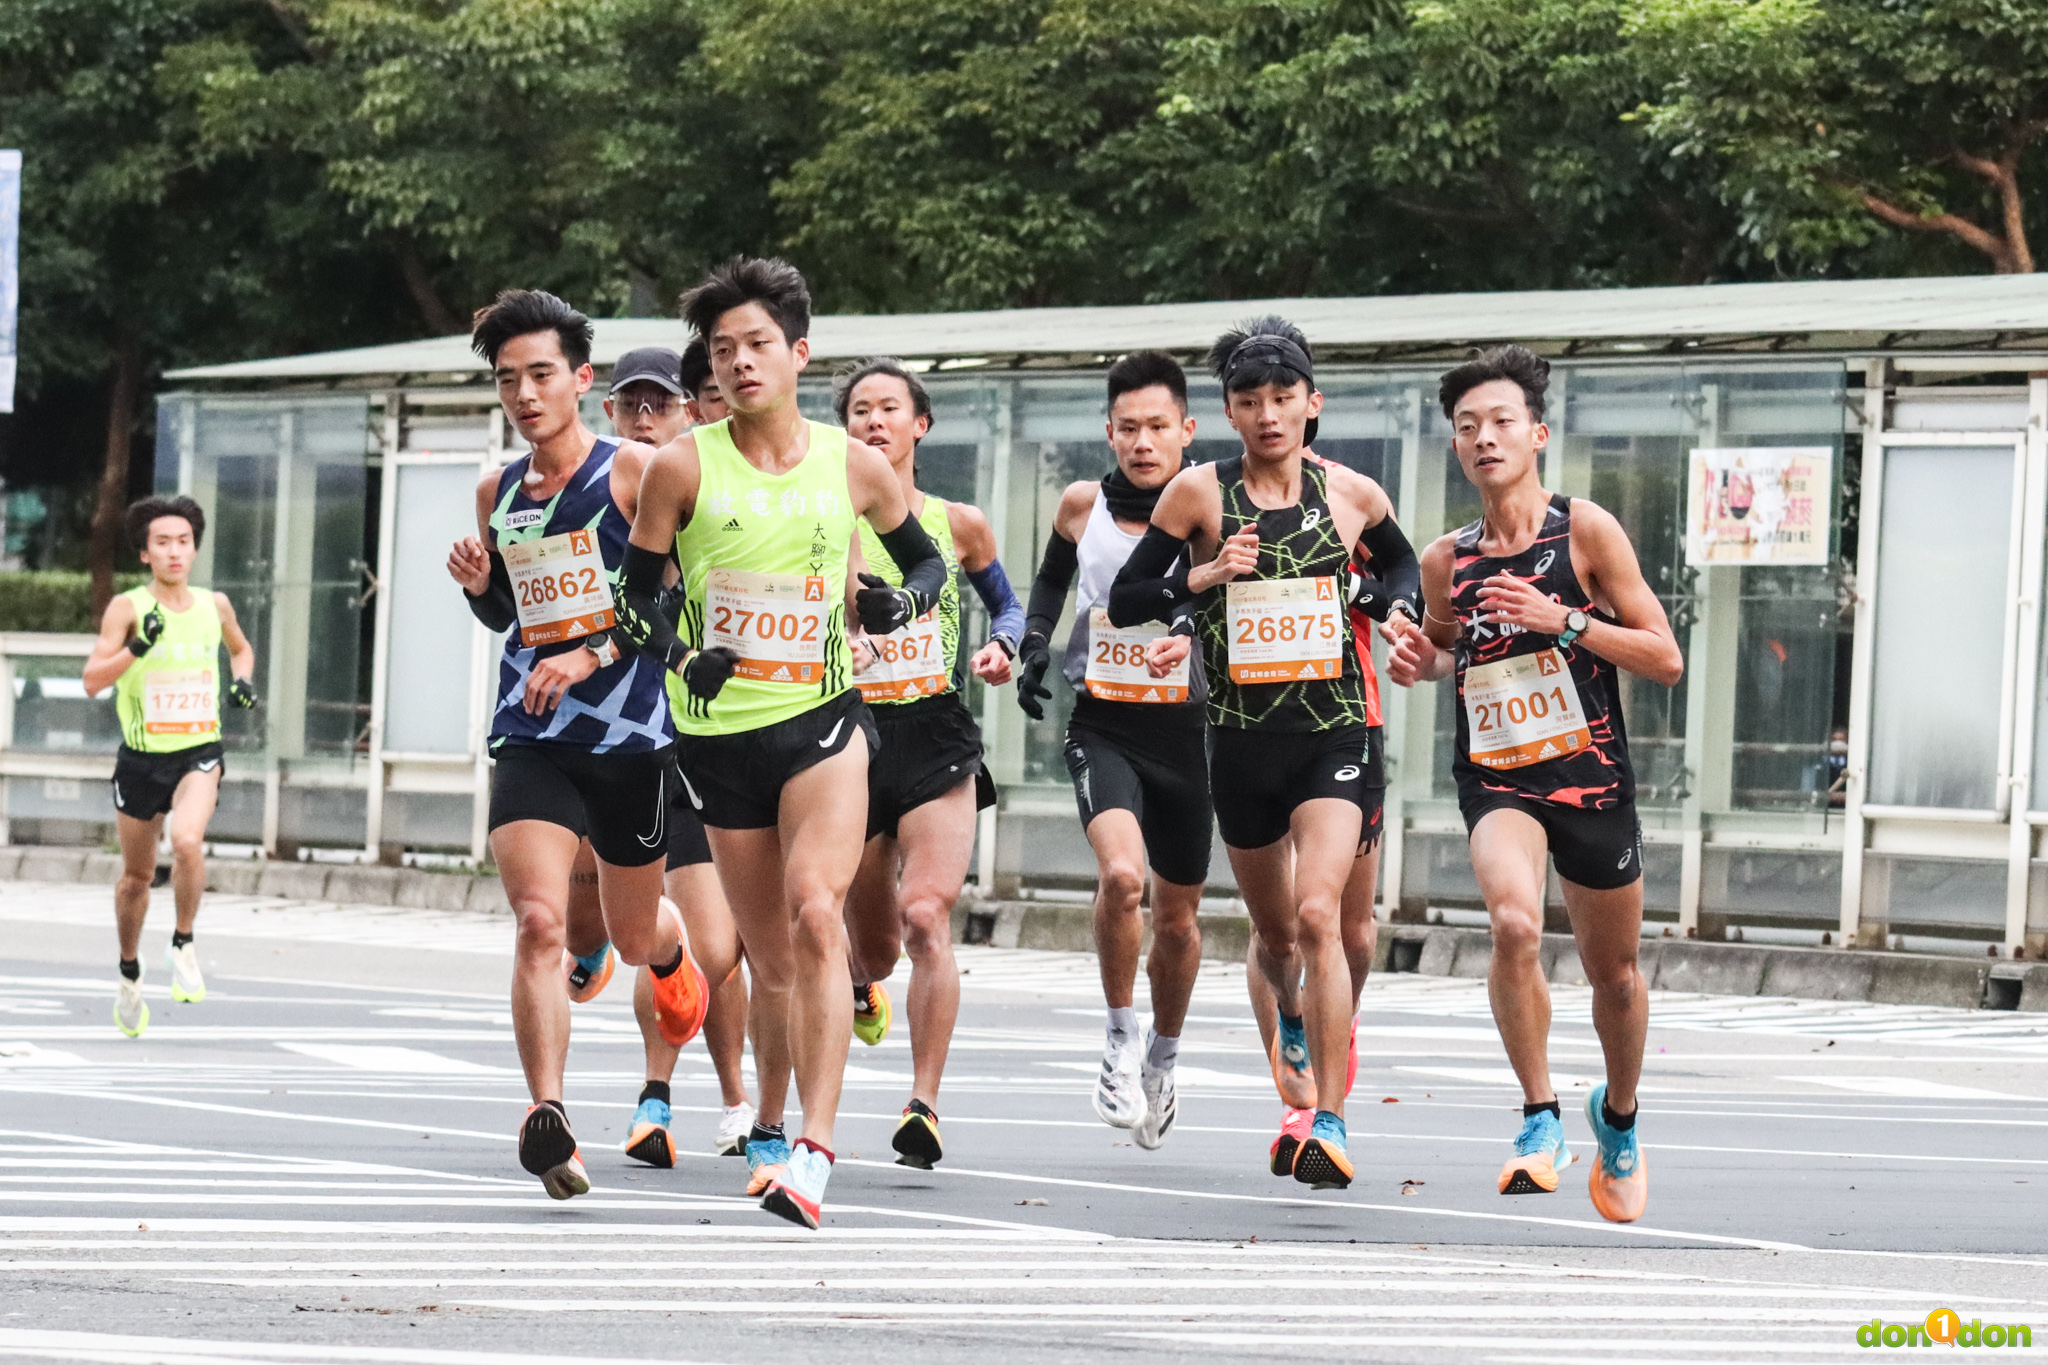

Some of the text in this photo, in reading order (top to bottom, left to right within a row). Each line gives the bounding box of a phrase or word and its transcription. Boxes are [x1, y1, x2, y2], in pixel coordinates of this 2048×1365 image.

[707, 488, 839, 516] 放電豹豹
[575, 538, 590, 554] A
[518, 567, 600, 607] 26862
[807, 583, 821, 600] A
[1319, 584, 1331, 599] A
[713, 606, 819, 641] 27002
[1236, 614, 1335, 644] 26875
[883, 634, 933, 663] 867
[1543, 658, 1558, 674] A
[153, 692, 211, 709] 17276
[1475, 686, 1568, 732] 27001
